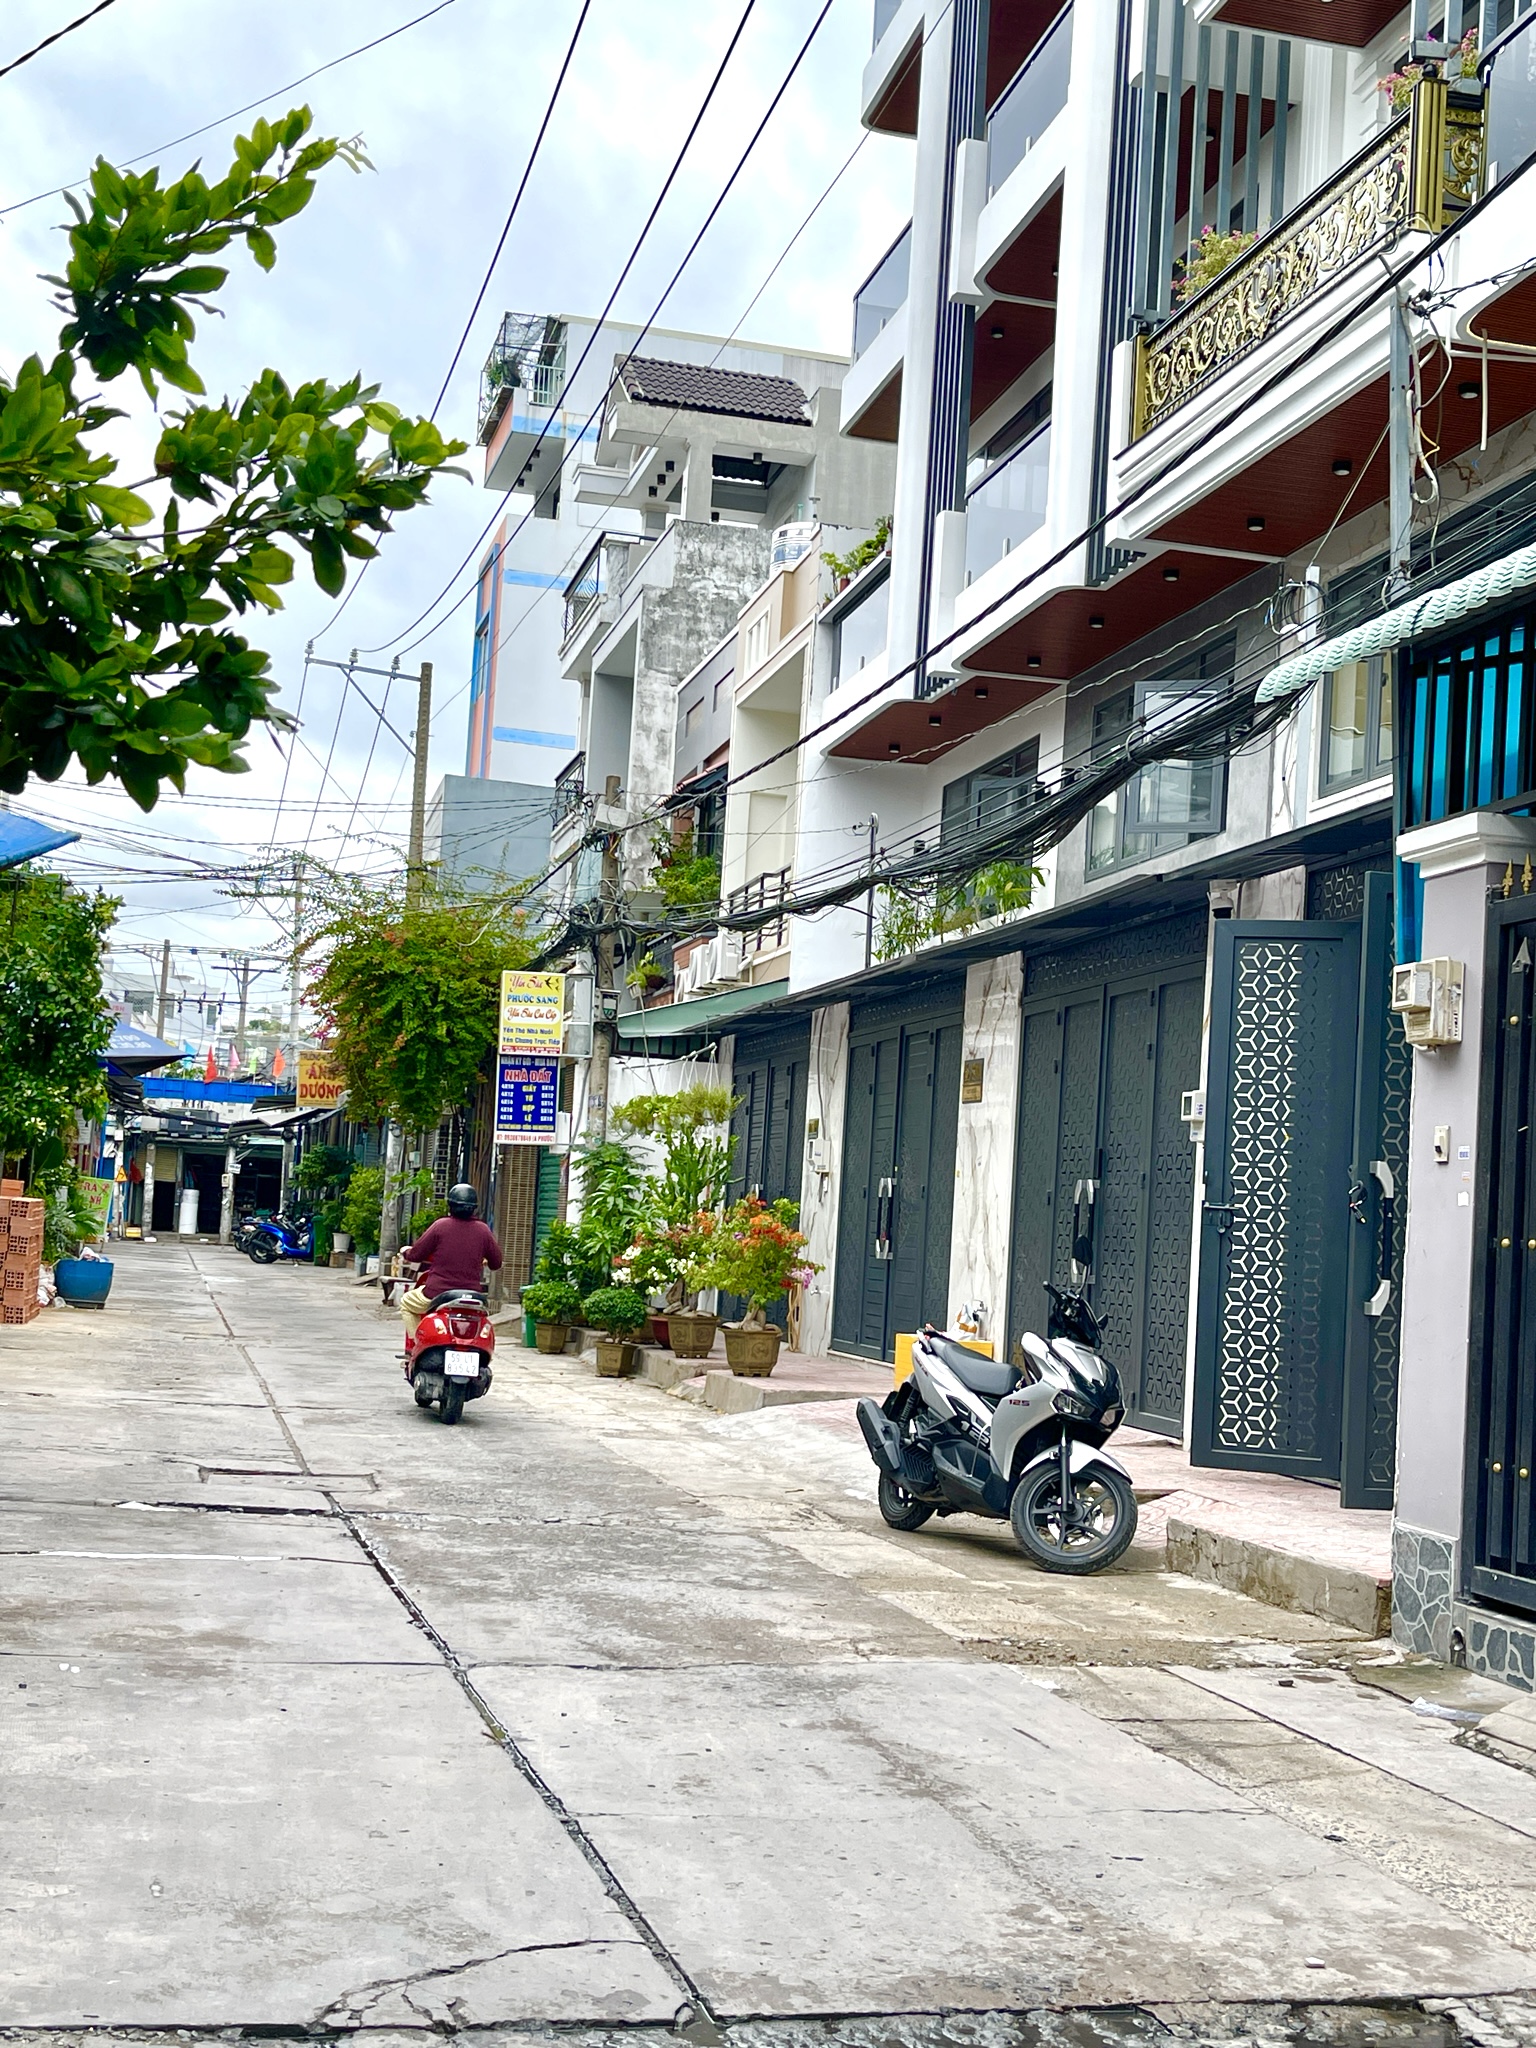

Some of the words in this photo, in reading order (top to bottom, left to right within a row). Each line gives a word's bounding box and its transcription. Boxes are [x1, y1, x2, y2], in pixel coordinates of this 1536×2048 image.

[536, 995, 559, 1004] SANG
[504, 1068, 528, 1082] NHÀ
[1009, 1399, 1030, 1407] 125
